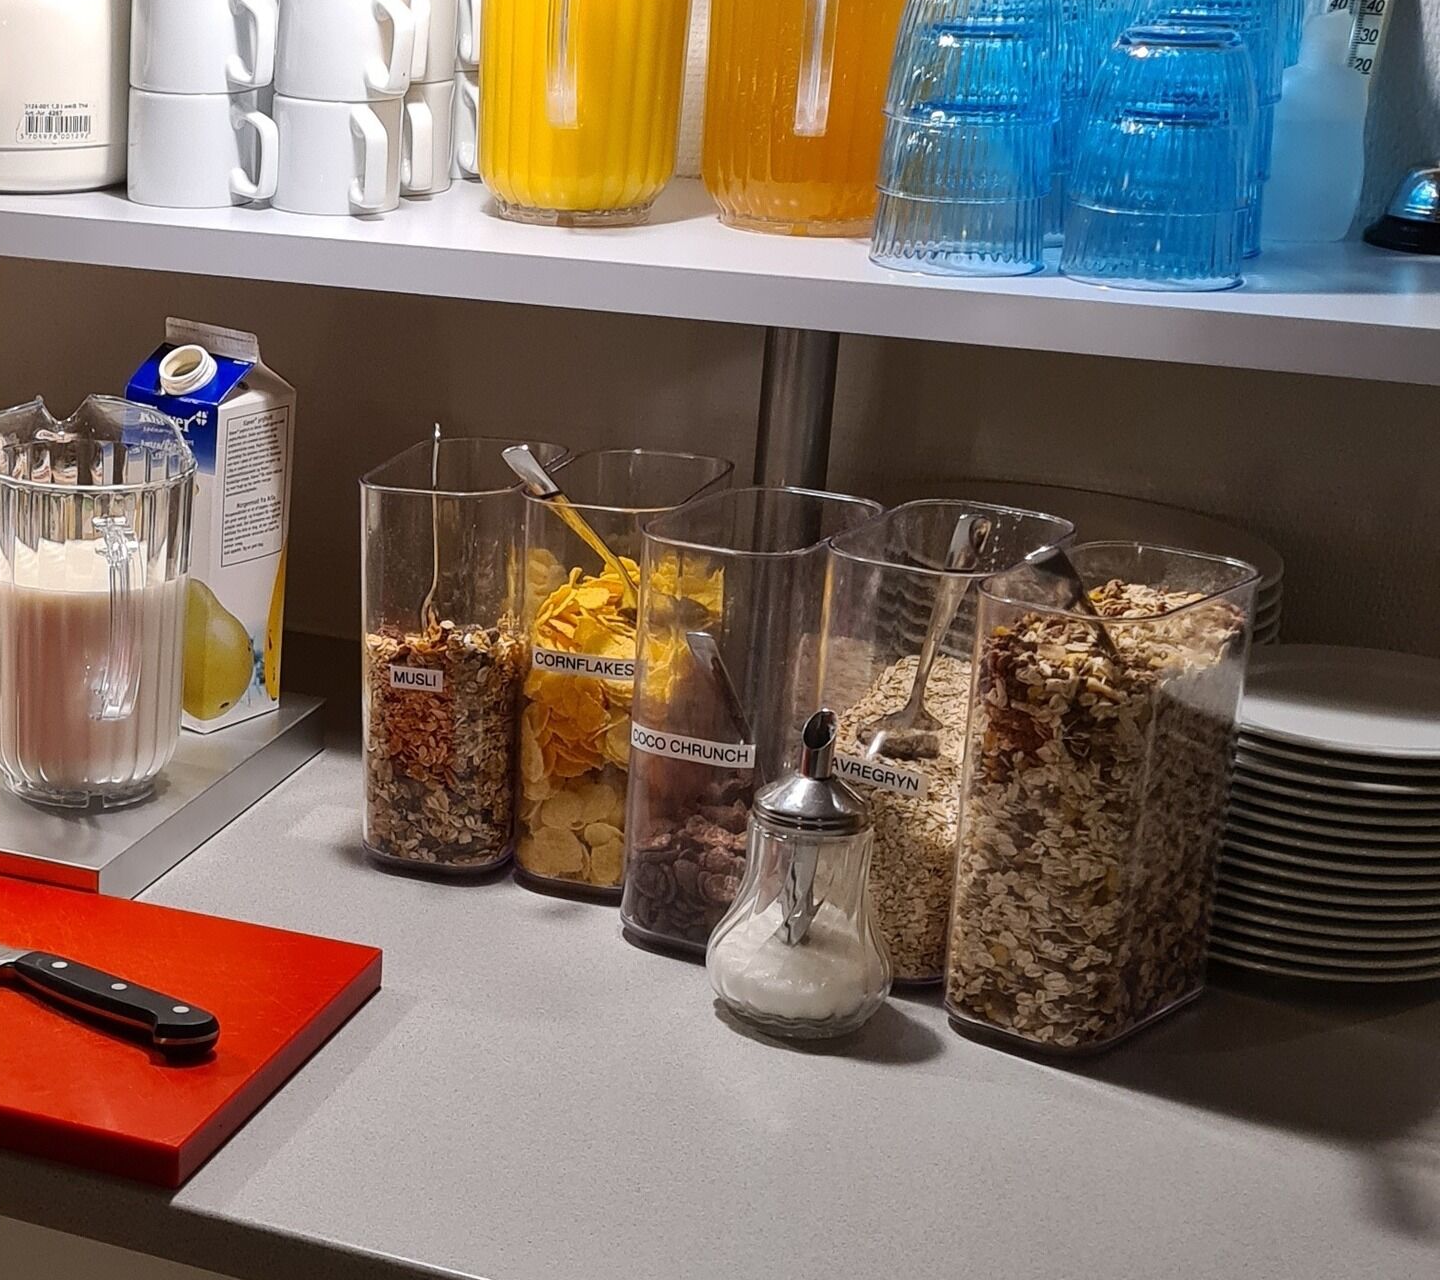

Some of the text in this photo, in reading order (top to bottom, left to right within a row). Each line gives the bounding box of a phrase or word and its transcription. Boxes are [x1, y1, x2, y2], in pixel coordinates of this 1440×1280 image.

[1359, 28, 1380, 42] 30
[1354, 57, 1373, 72] 20
[535, 652, 635, 677] CORNFLAKES
[393, 671, 437, 687] MUSLI
[632, 728, 749, 763] COCO CHRUNCH
[831, 757, 920, 791] AVREGRYN
